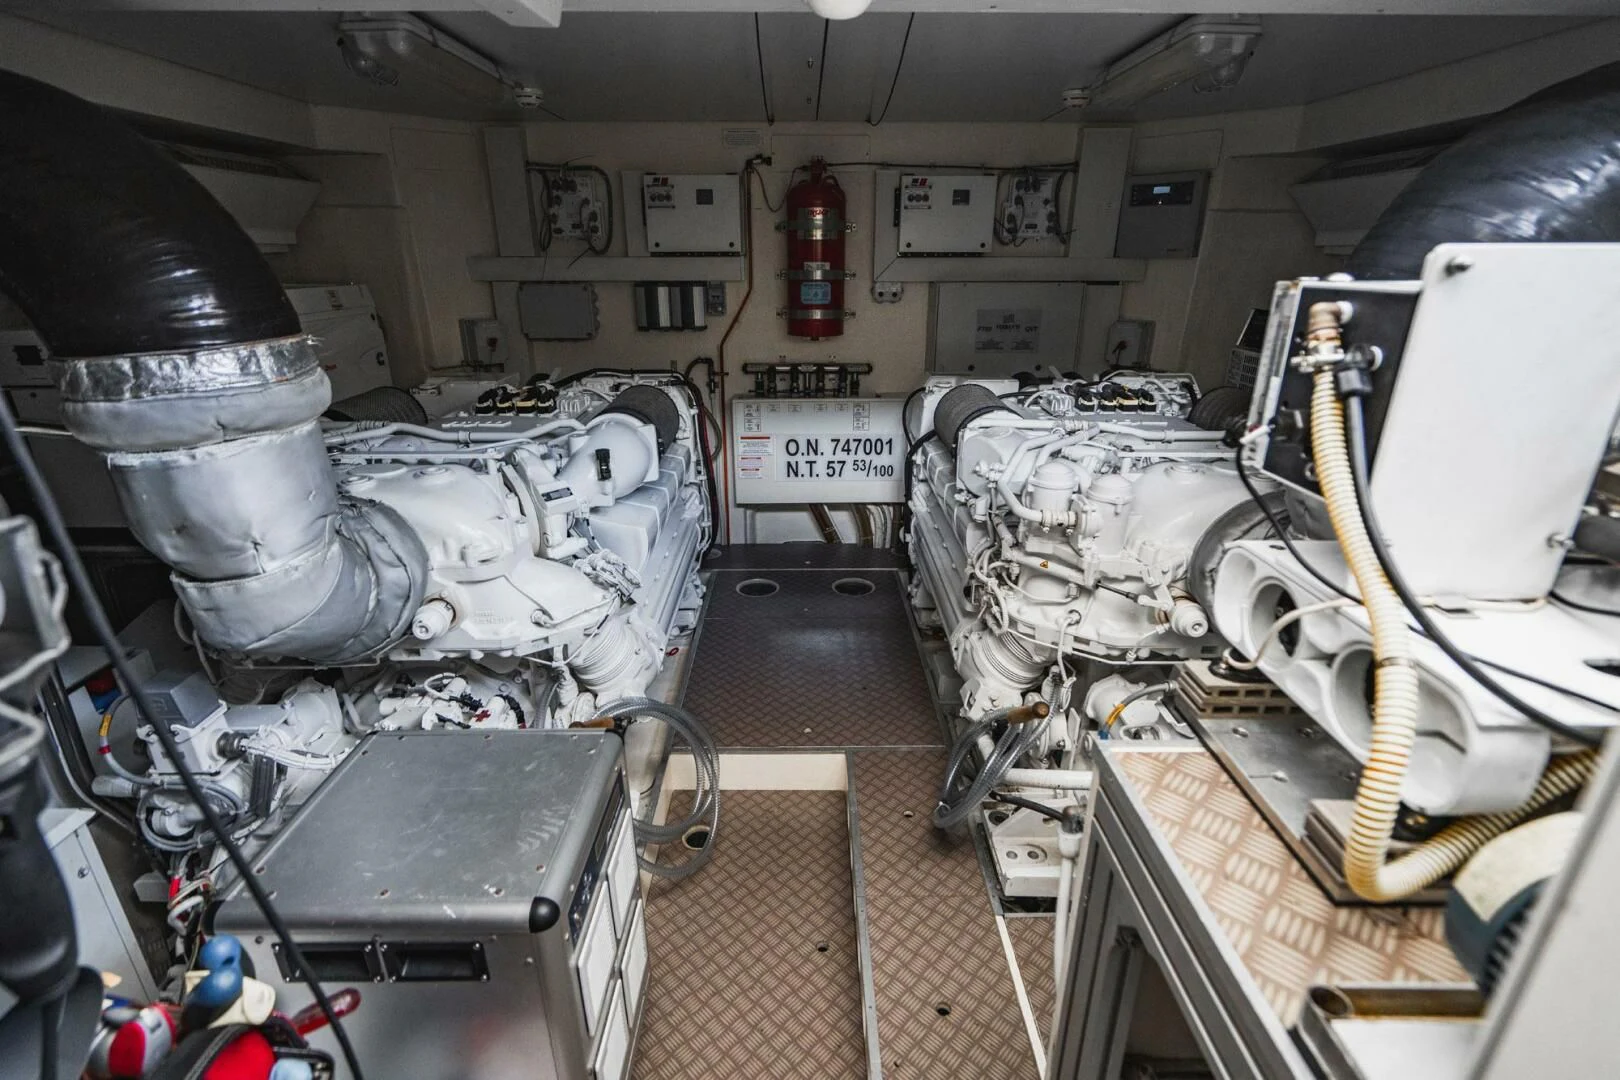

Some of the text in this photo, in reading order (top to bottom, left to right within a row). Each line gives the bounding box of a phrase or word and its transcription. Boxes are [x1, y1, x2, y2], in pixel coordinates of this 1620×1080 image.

[785, 438, 824, 457] O.N.
[830, 438, 893, 456] 747001
[786, 460, 820, 478] N.T.
[826, 460, 847, 478] 57
